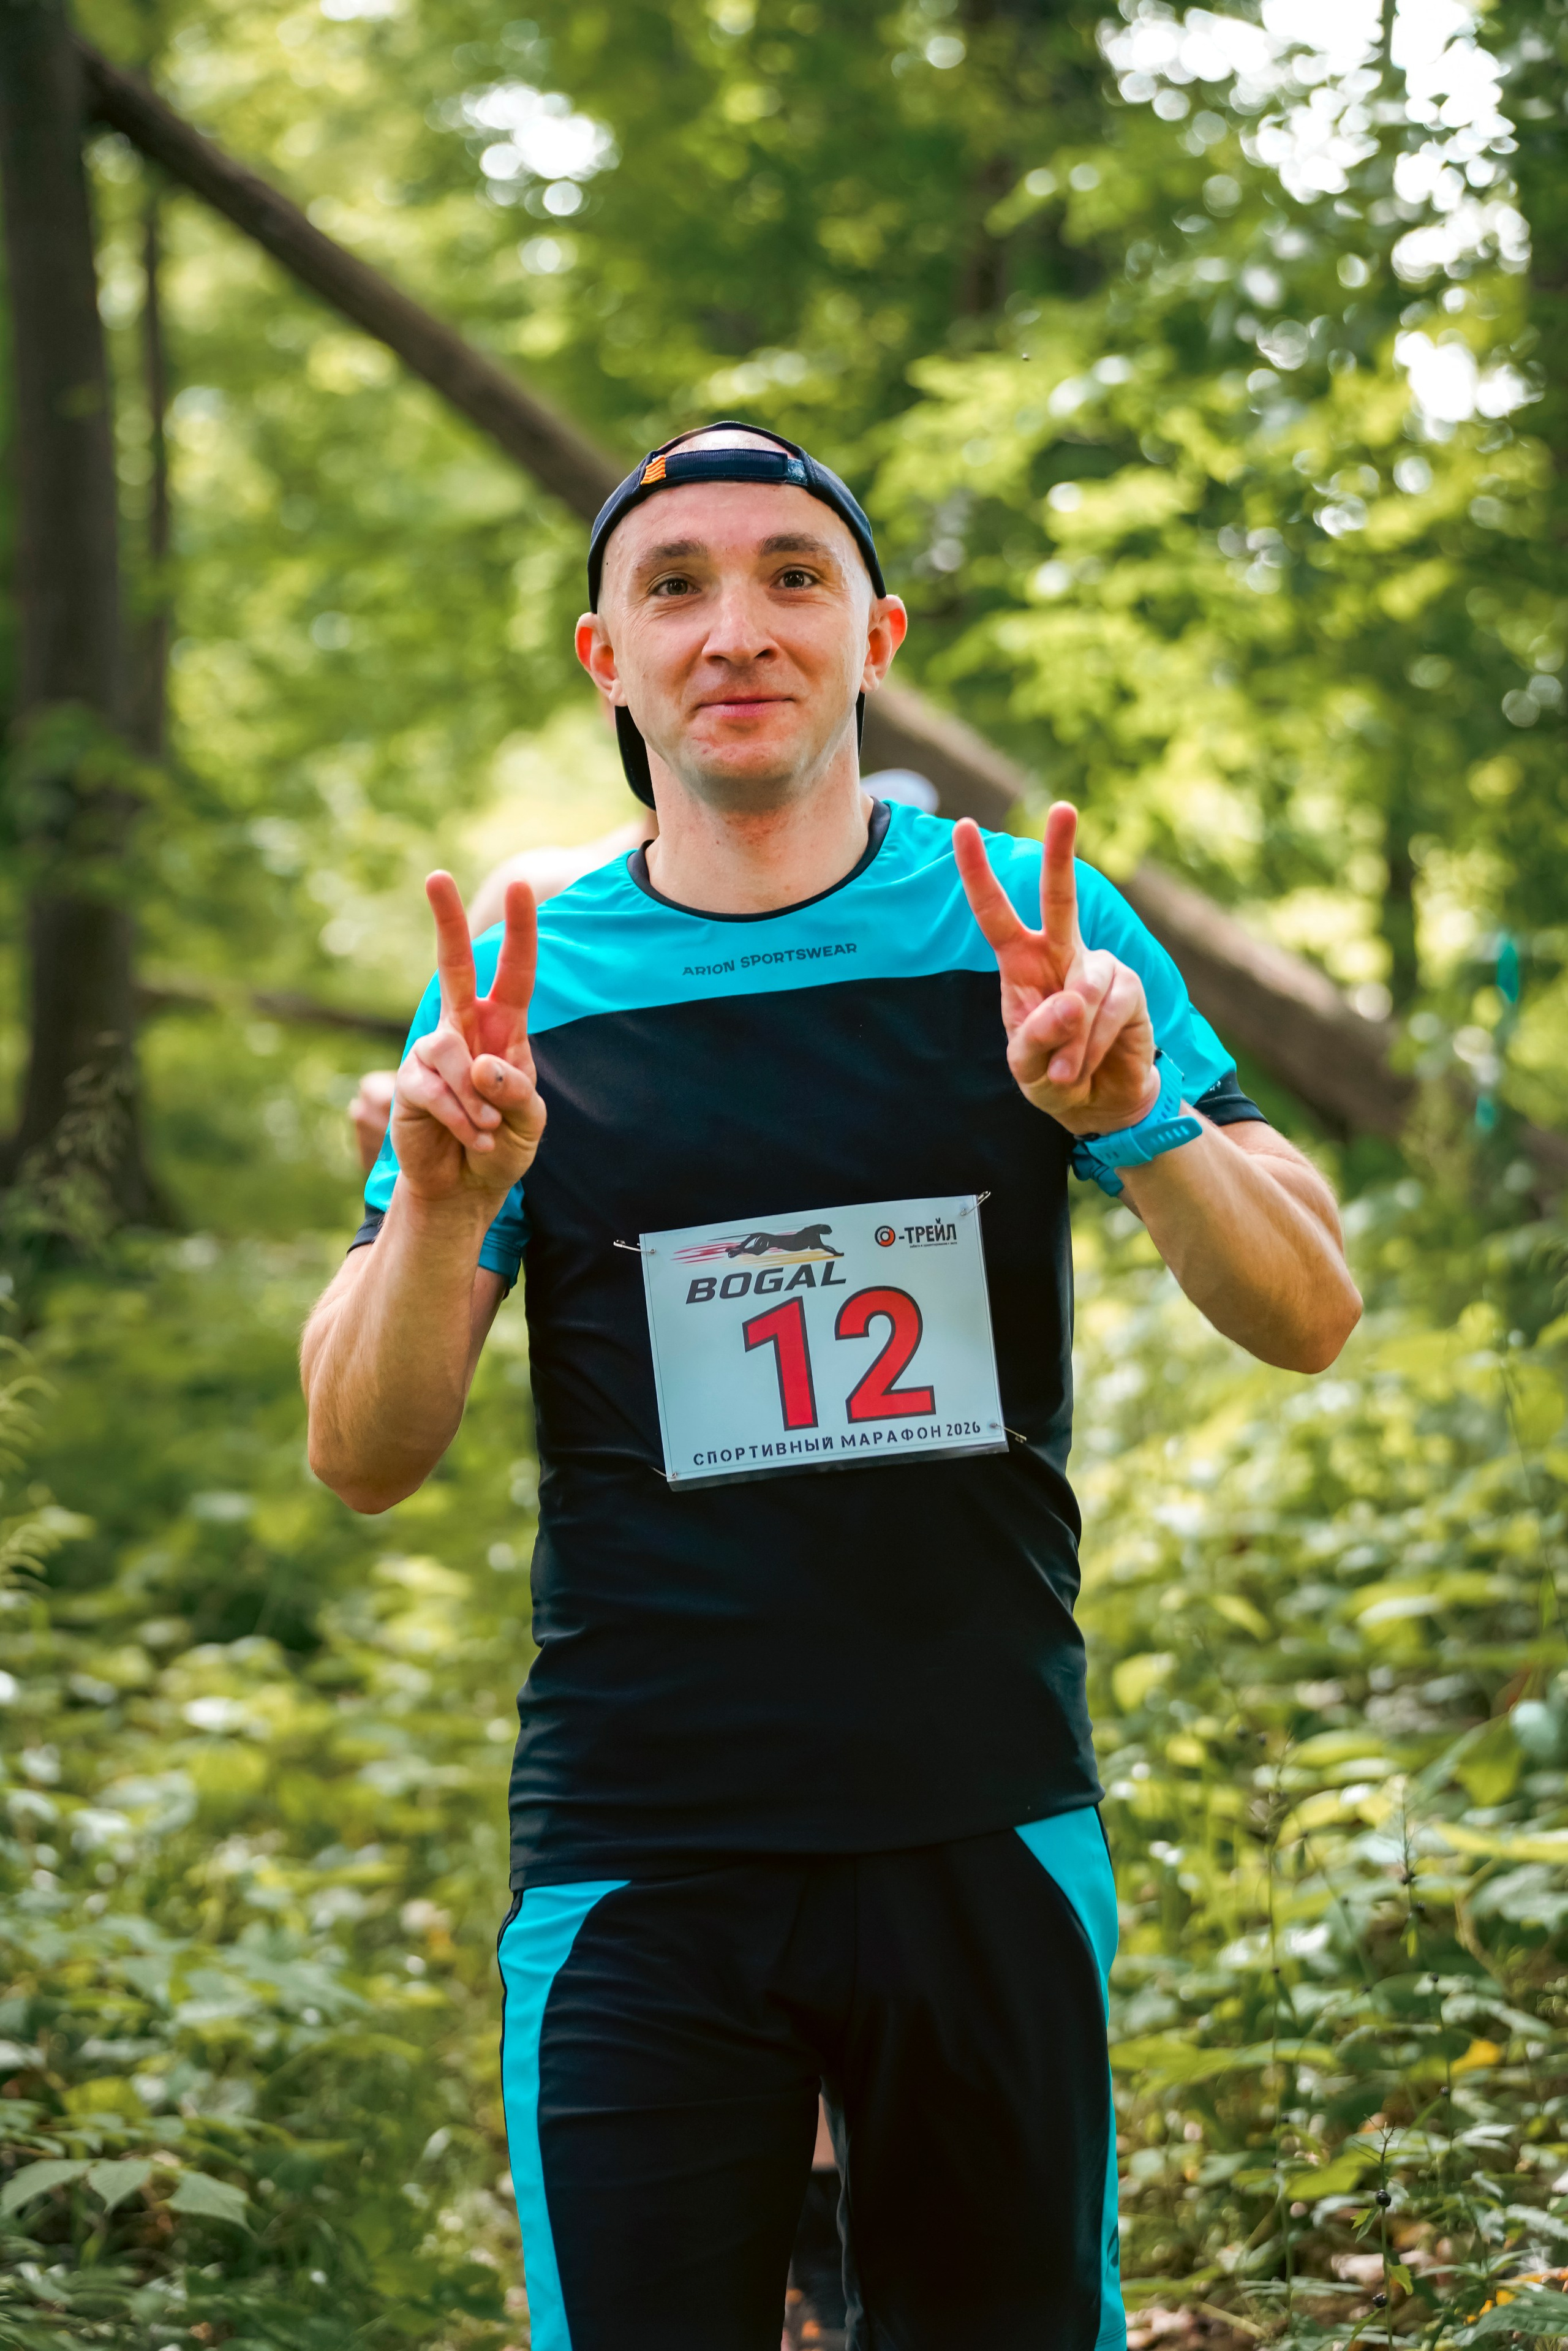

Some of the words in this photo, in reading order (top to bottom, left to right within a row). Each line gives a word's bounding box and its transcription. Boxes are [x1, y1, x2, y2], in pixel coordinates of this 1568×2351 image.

[682, 959, 736, 976] ARION
[740, 942, 858, 969] SPORTSWEAR
[685, 1261, 846, 1305] BOGAL
[742, 1285, 937, 1432] 12
[693, 1436, 834, 1466] СПОРТИВНЫЙ
[840, 1424, 941, 1448] МАРАФОН
[946, 1421, 981, 1436] 2026
